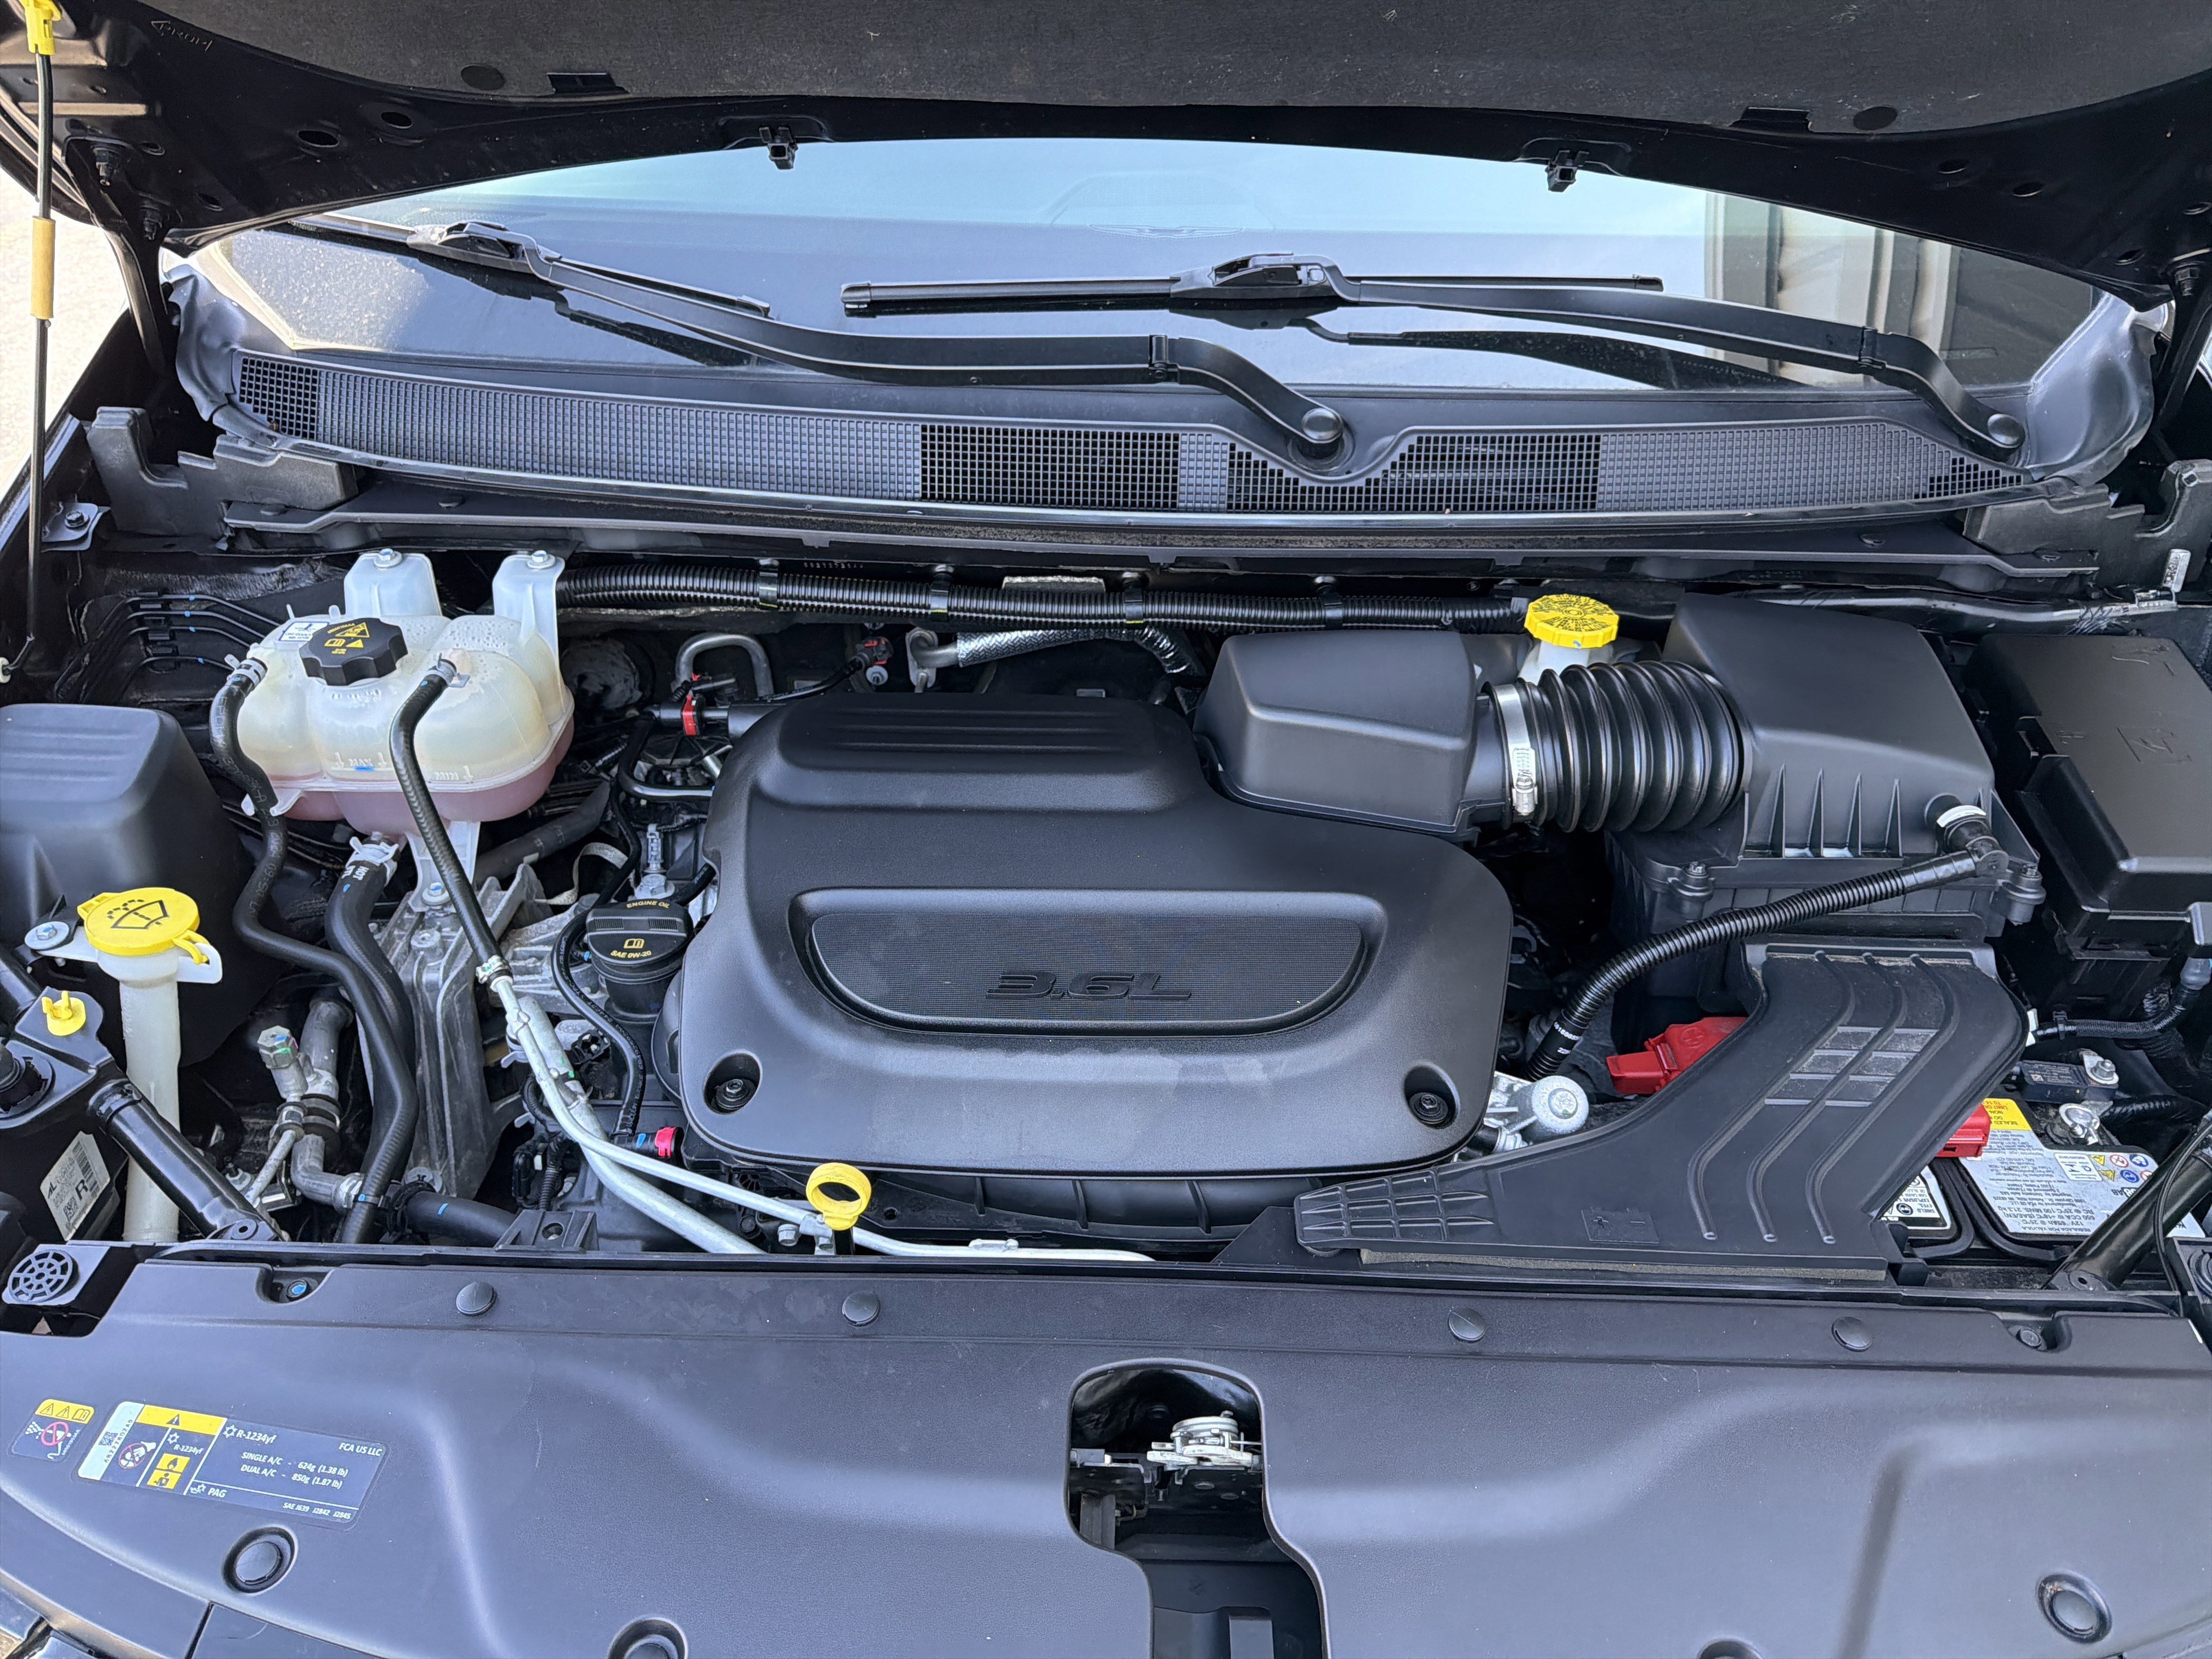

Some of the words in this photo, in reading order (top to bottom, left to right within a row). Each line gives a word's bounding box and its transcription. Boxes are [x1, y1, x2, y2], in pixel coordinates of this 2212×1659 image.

[626, 900, 657, 909] ENGINE
[658, 901, 670, 910] OIL
[610, 949, 627, 958] SAE
[627, 950, 652, 958] 0W-20
[986, 970, 1192, 1001] 3.6L
[75, 1179, 89, 1201] R
[235, 1429, 277, 1444] R-1234yf
[173, 1443, 204, 1455] R-1234yf
[338, 1442, 354, 1452] FCA
[356, 1445, 368, 1453] US
[368, 1447, 382, 1457] LLC
[241, 1452, 268, 1463] SINGLE
[267, 1456, 283, 1465] A/C
[297, 1462, 317, 1473] 624g
[317, 1464, 338, 1475] (1.38
[337, 1468, 349, 1477] lb)
[240, 1464, 261, 1475] DUAL
[261, 1468, 277, 1477] A/C
[291, 1474, 311, 1484] 850g
[312, 1476, 330, 1486] (1.87
[331, 1480, 343, 1489] lb)
[208, 1487, 227, 1498] PAG
[295, 1504, 310, 1513] J639
